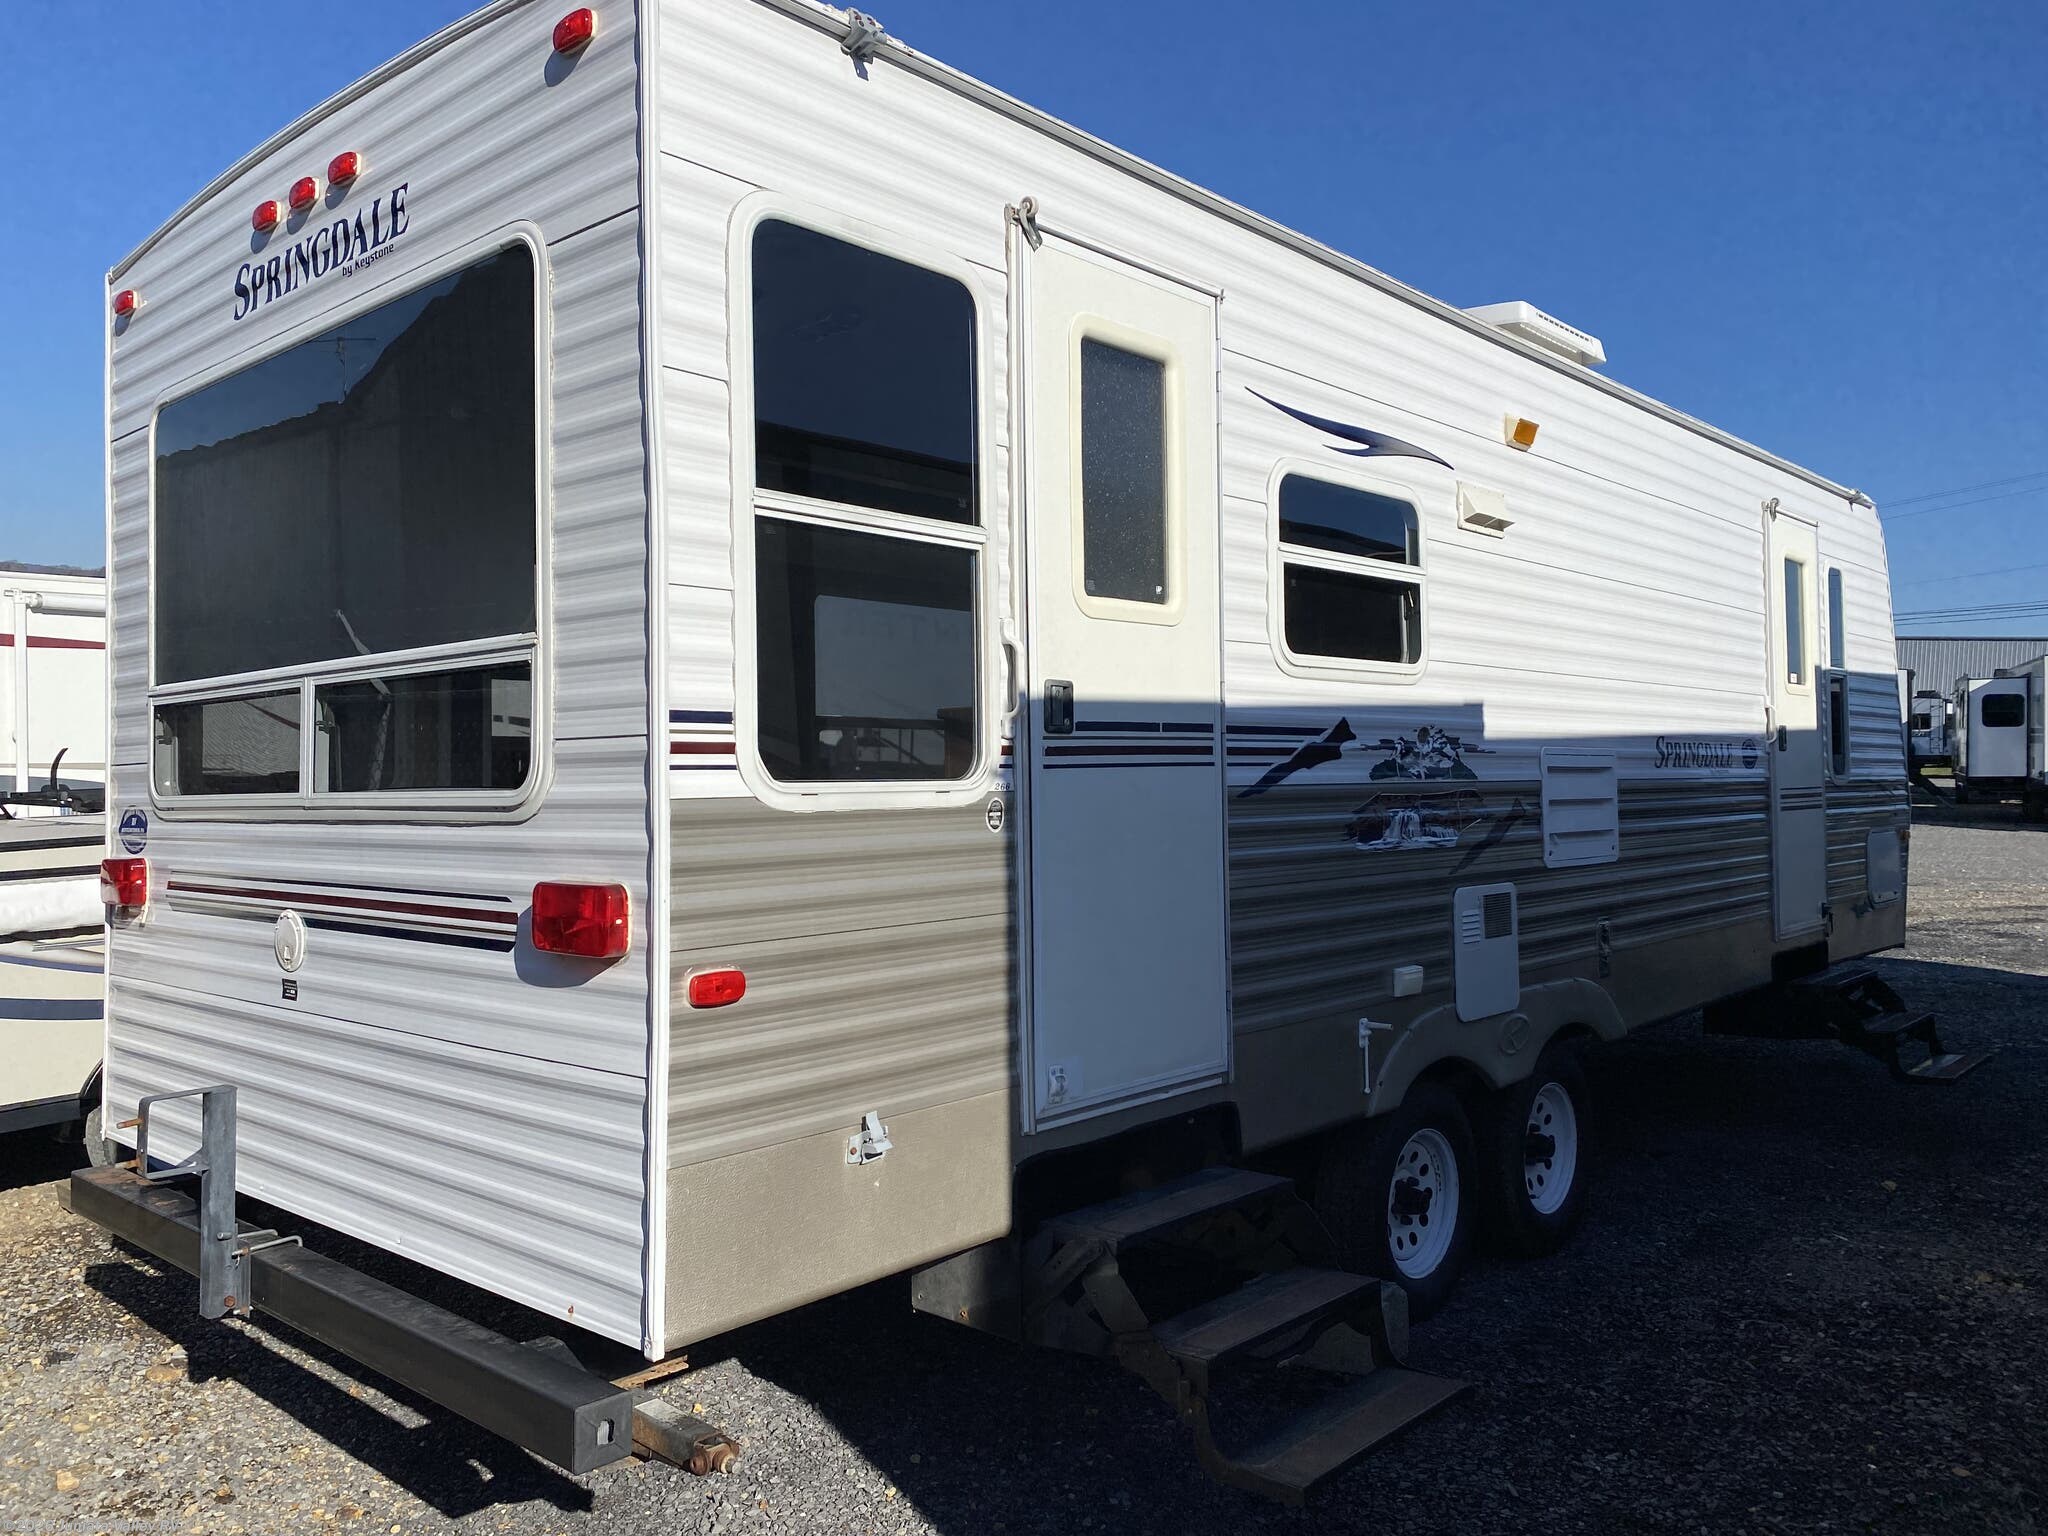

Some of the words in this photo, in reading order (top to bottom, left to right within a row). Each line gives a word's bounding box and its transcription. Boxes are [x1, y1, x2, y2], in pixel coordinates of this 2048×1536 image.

[233, 182, 410, 321] SPRINGDALE
[342, 264, 353, 278] by
[1654, 735, 1733, 769] SPRINGDALE
